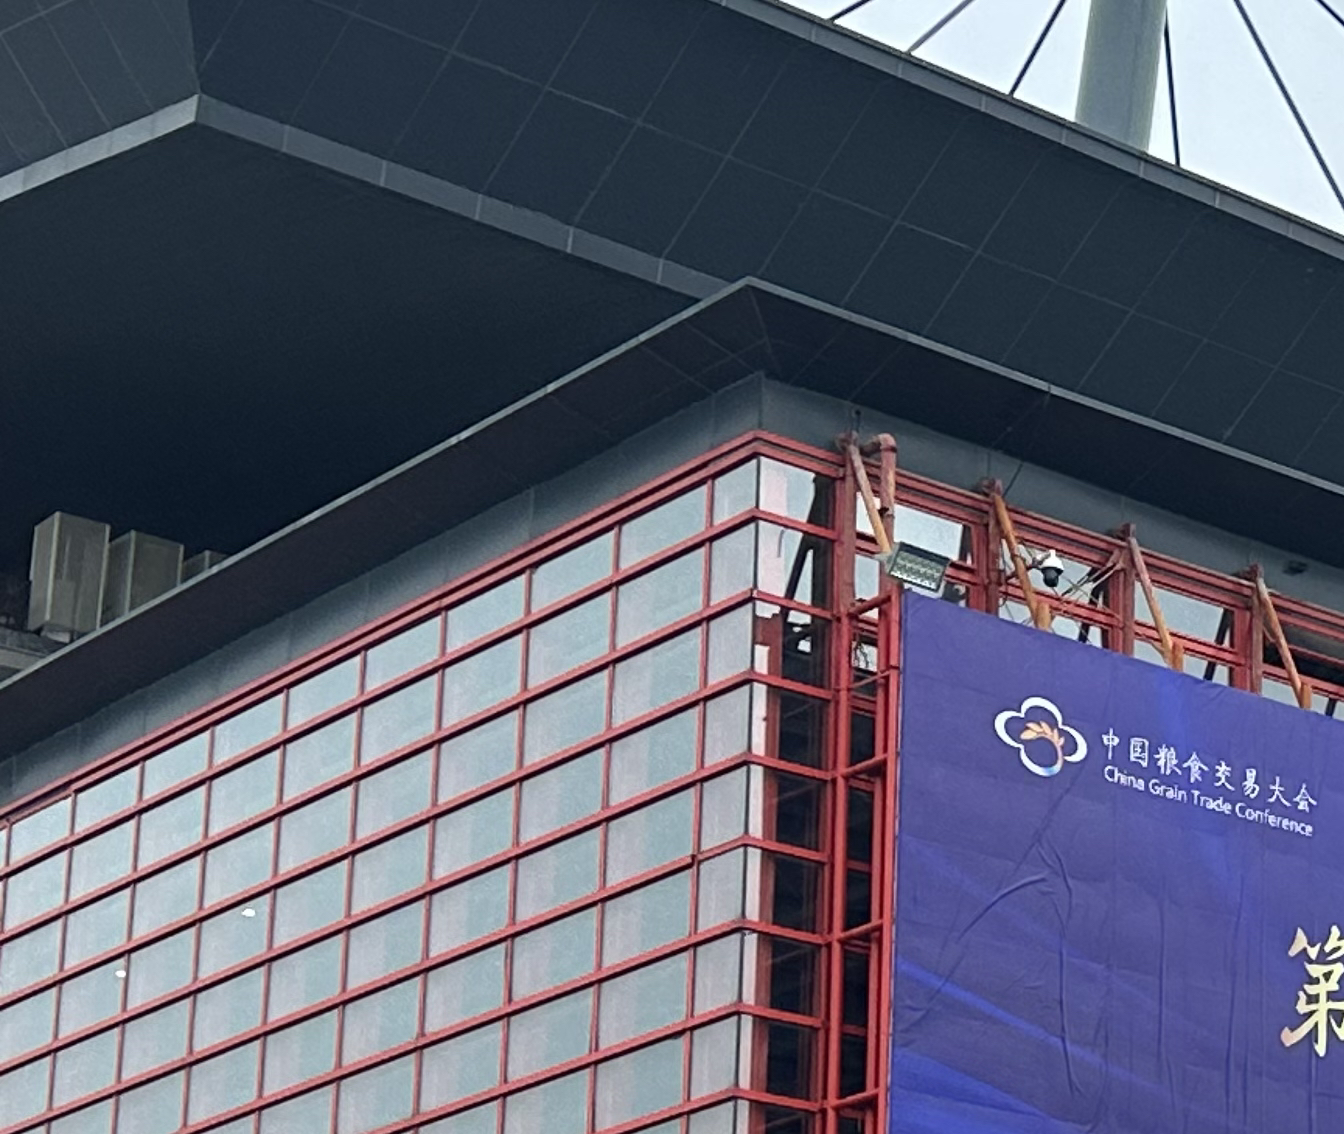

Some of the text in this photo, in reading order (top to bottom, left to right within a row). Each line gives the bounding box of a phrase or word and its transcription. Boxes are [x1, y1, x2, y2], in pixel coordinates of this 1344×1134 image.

[1101, 728, 1317, 813] 中国粮食交易大会
[1104, 765, 1313, 837] China Grain Trade Conference
